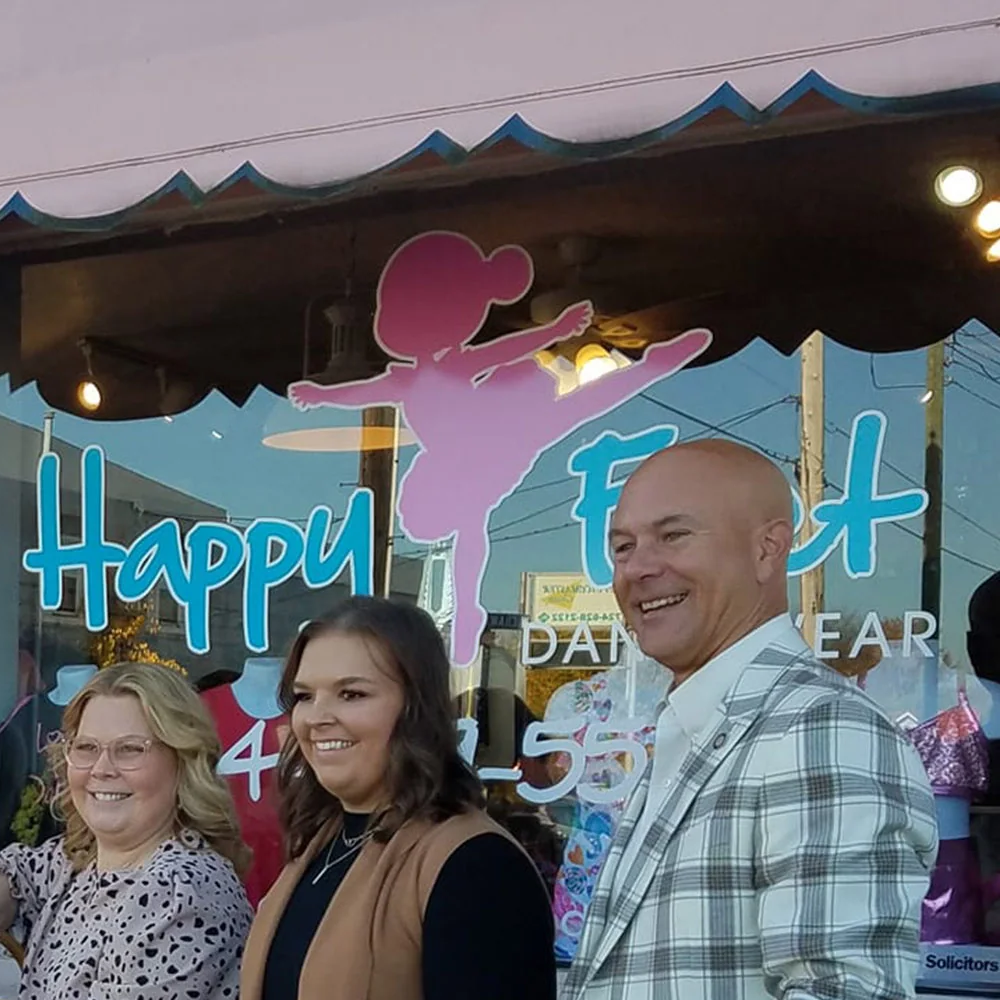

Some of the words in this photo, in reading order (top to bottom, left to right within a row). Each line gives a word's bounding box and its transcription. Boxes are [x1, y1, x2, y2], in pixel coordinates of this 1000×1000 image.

[24, 445, 374, 654] Happy
[568, 405, 930, 588] Ft
[522, 610, 936, 665] DANEAR
[925, 954, 999, 972] Solicitors
